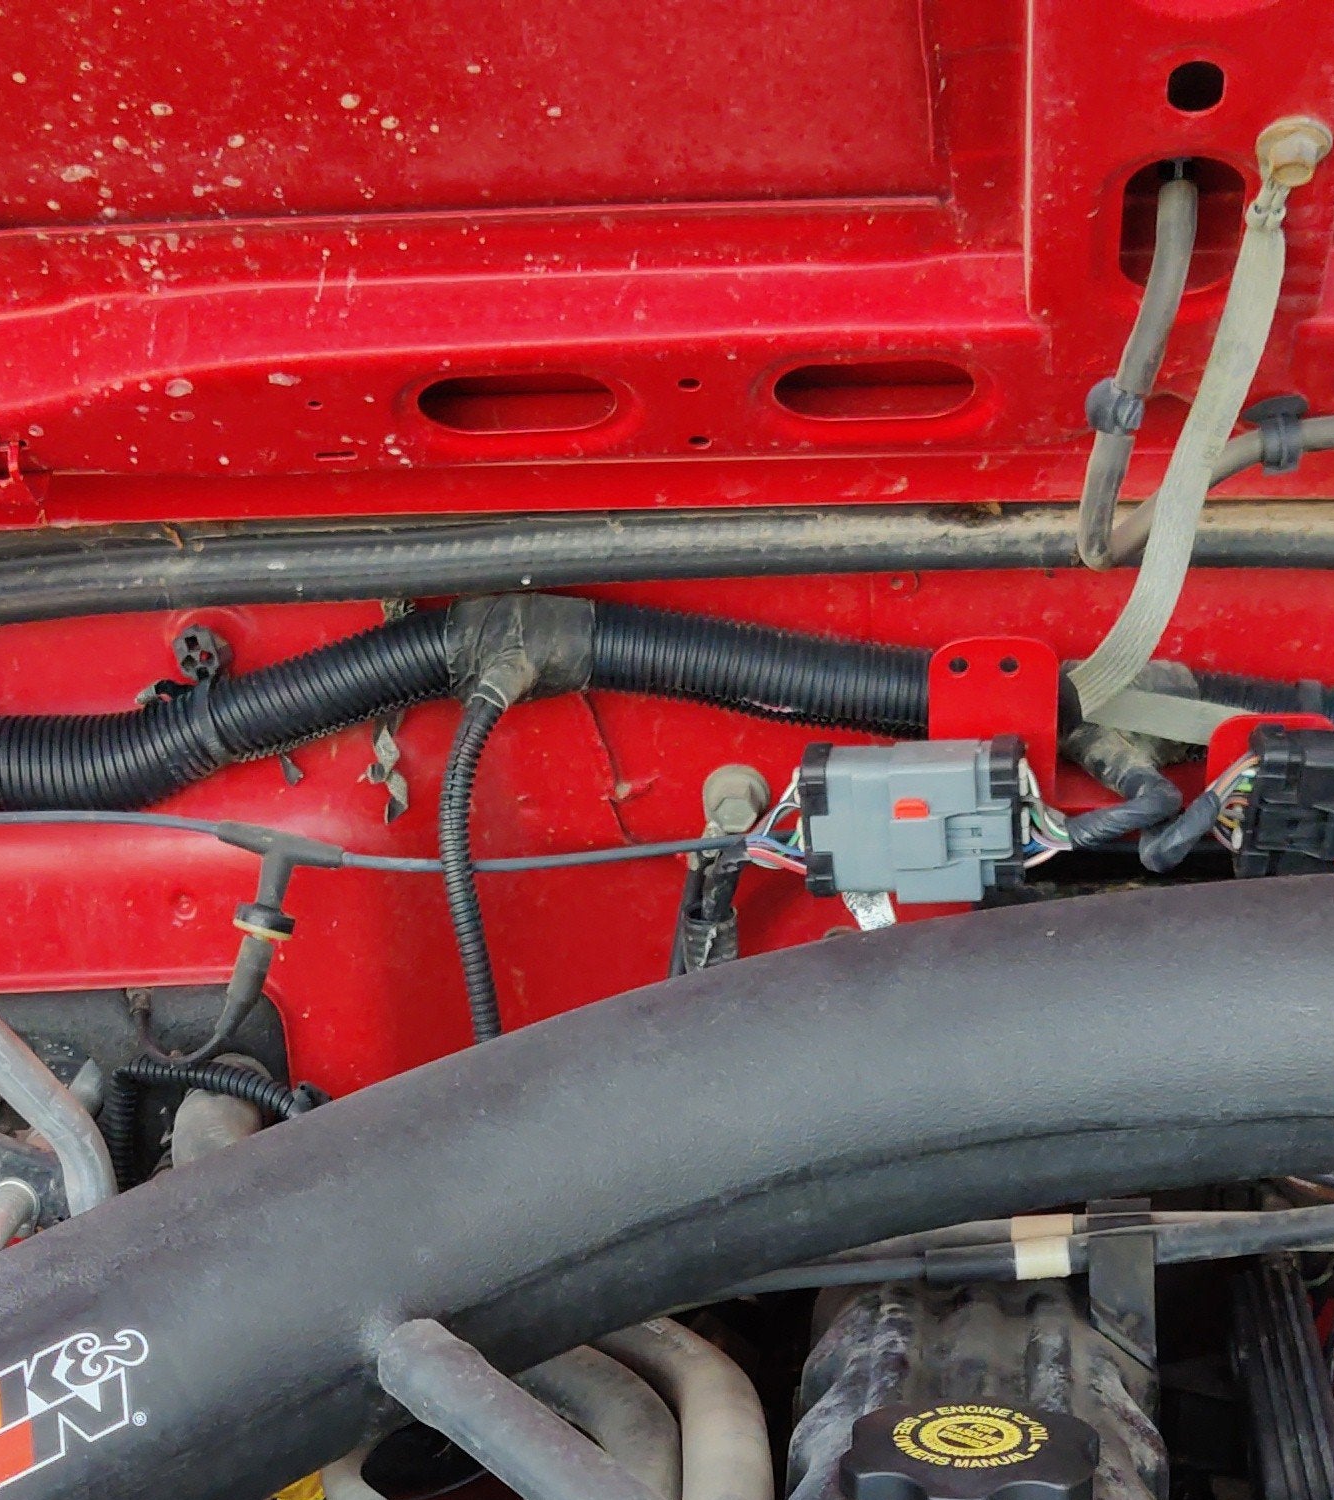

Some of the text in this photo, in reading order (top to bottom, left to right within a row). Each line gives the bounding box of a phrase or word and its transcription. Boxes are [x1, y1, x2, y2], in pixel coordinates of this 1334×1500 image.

[25, 1329, 149, 1456] K&N
[892, 1417, 921, 1435] SEE
[935, 1405, 1049, 1443] ENGINE OIL
[892, 1434, 952, 1466] OWNERS
[953, 1451, 1035, 1469] MANUAL
